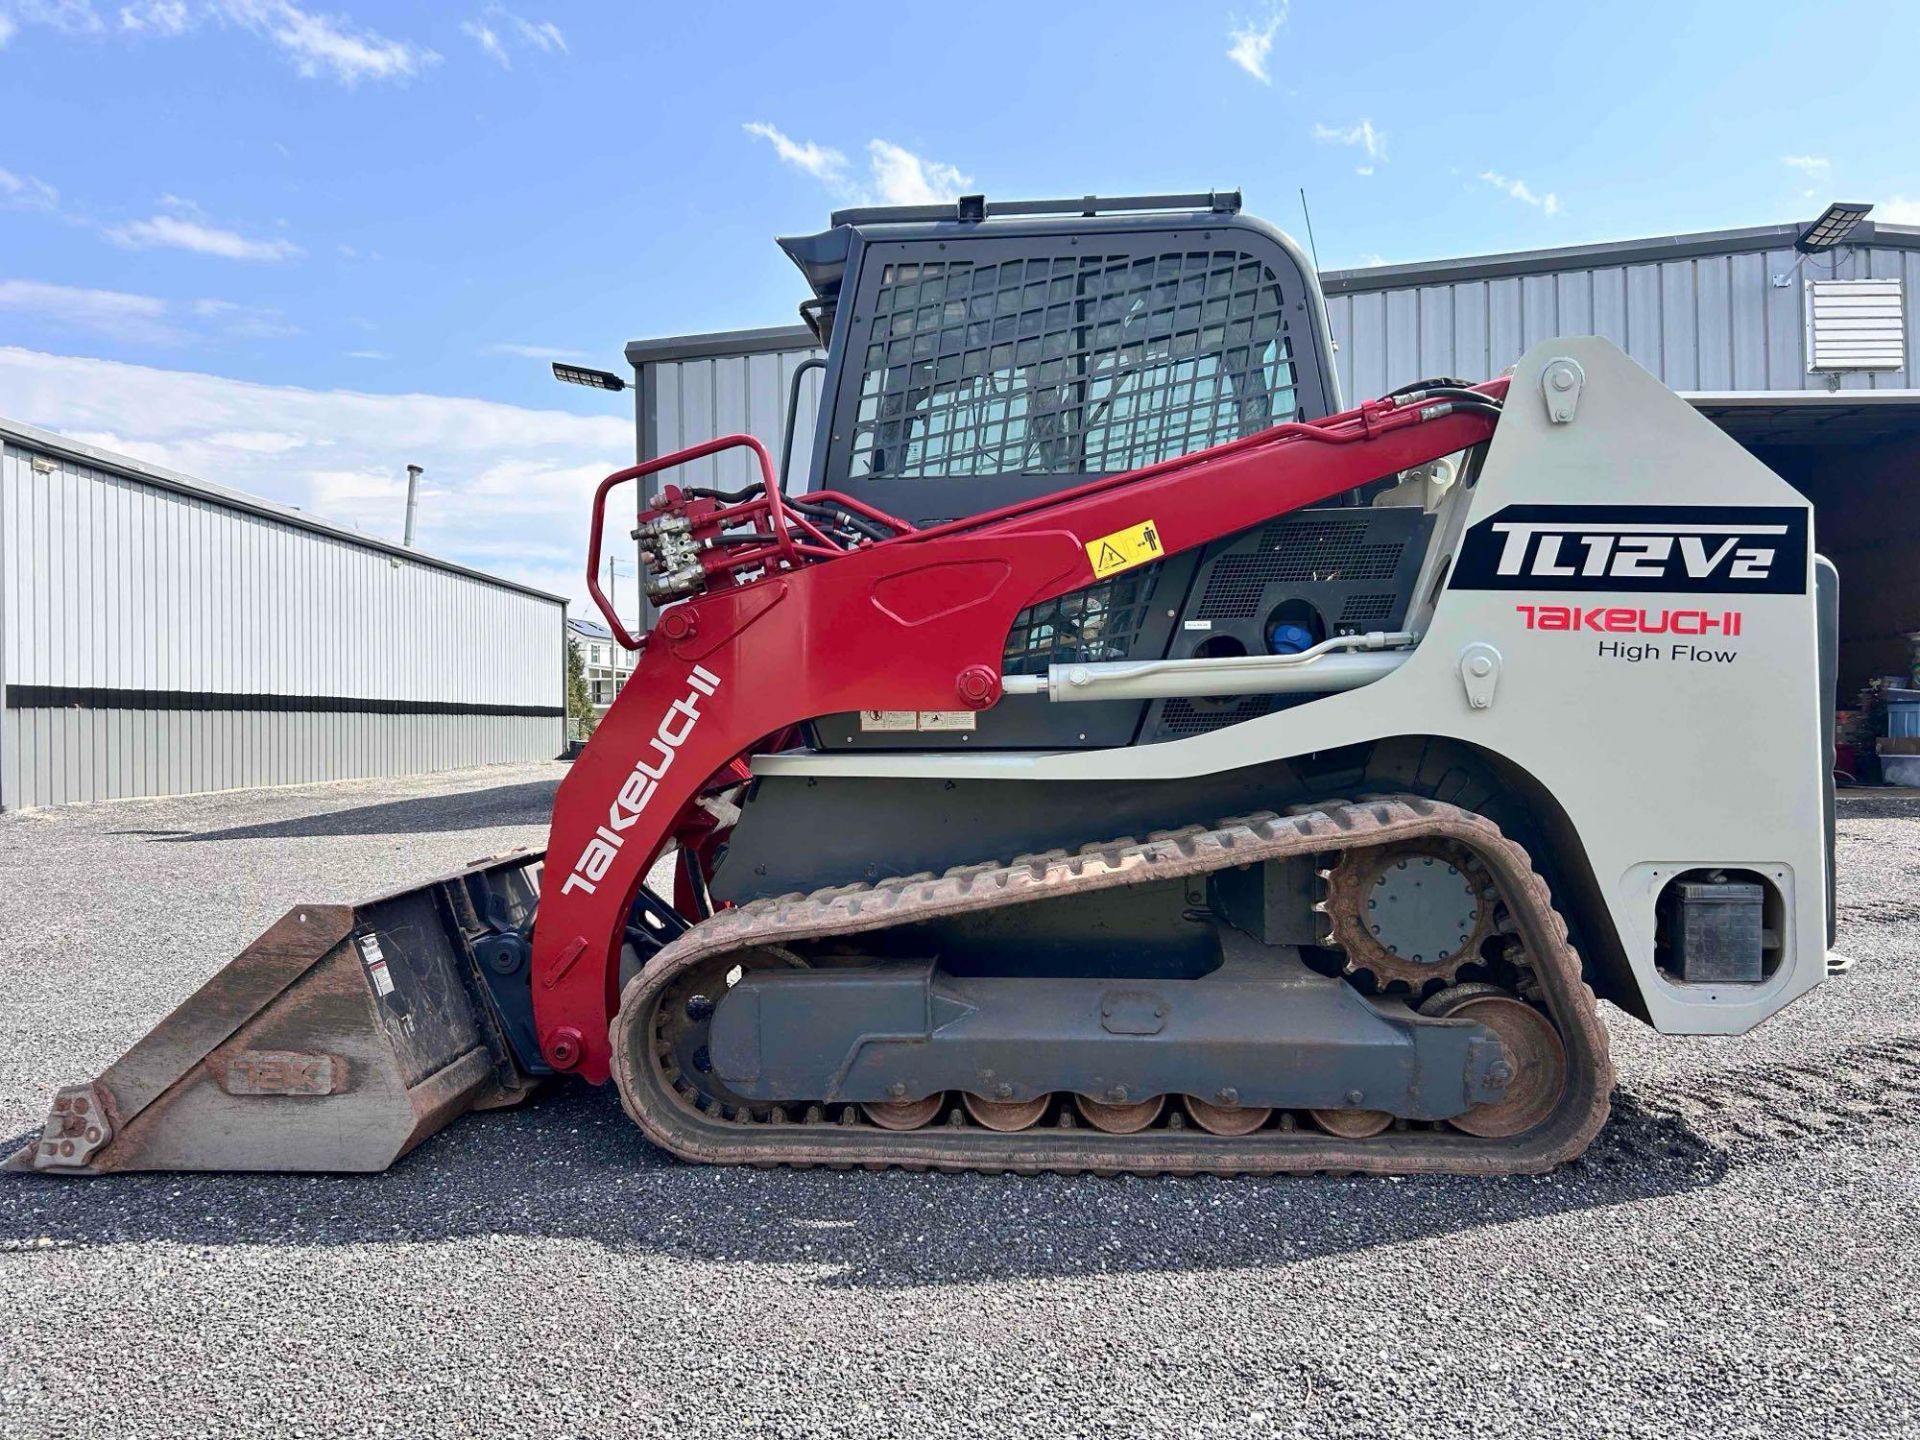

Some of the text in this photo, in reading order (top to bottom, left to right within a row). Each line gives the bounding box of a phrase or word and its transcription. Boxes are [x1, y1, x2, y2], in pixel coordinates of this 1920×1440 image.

[1491, 522, 1788, 579] TL12V2
[1515, 604, 1742, 636] TAKEUCHI
[1598, 640, 1737, 664] High Flow
[561, 664, 721, 896] TAKEUCHI
